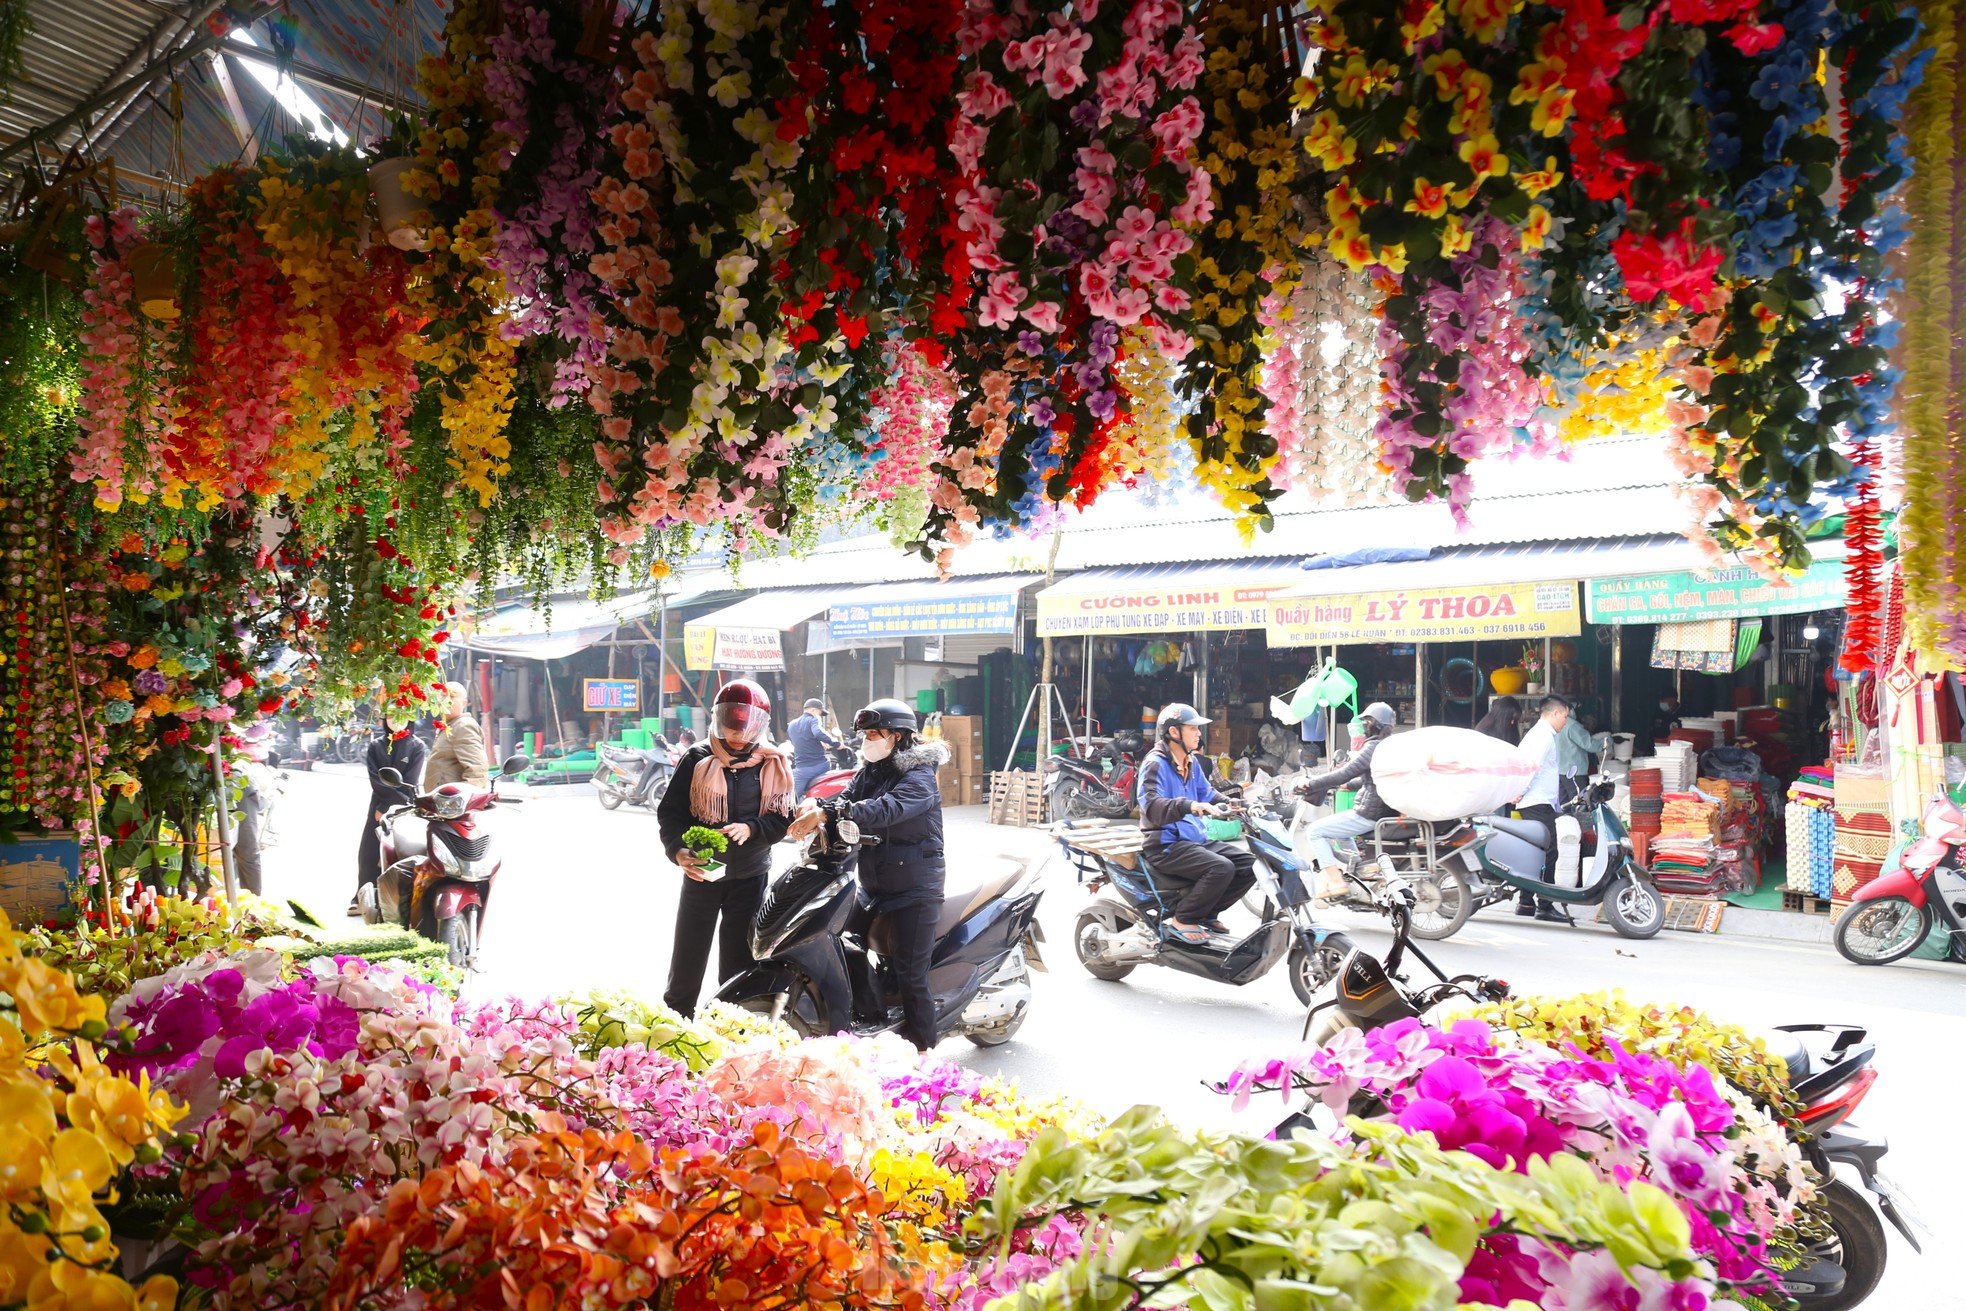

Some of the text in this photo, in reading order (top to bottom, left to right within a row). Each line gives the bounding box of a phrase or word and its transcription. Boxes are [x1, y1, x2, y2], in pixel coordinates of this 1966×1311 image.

[1080, 592, 1219, 610] CƯỜNG LINH
[1365, 593, 1517, 622] LÝ THOA
[1143, 614, 1154, 627] XE
[1176, 612, 1187, 626] XE
[1212, 610, 1222, 624] XE
[1250, 609, 1261, 623] XE
[1275, 604, 1310, 626] Quầy
[1315, 605, 1353, 625] hàng
[1670, 612, 1687, 621] 277
[1528, 622, 1546, 632] 456
[588, 683, 621, 706] GIỮ XE
